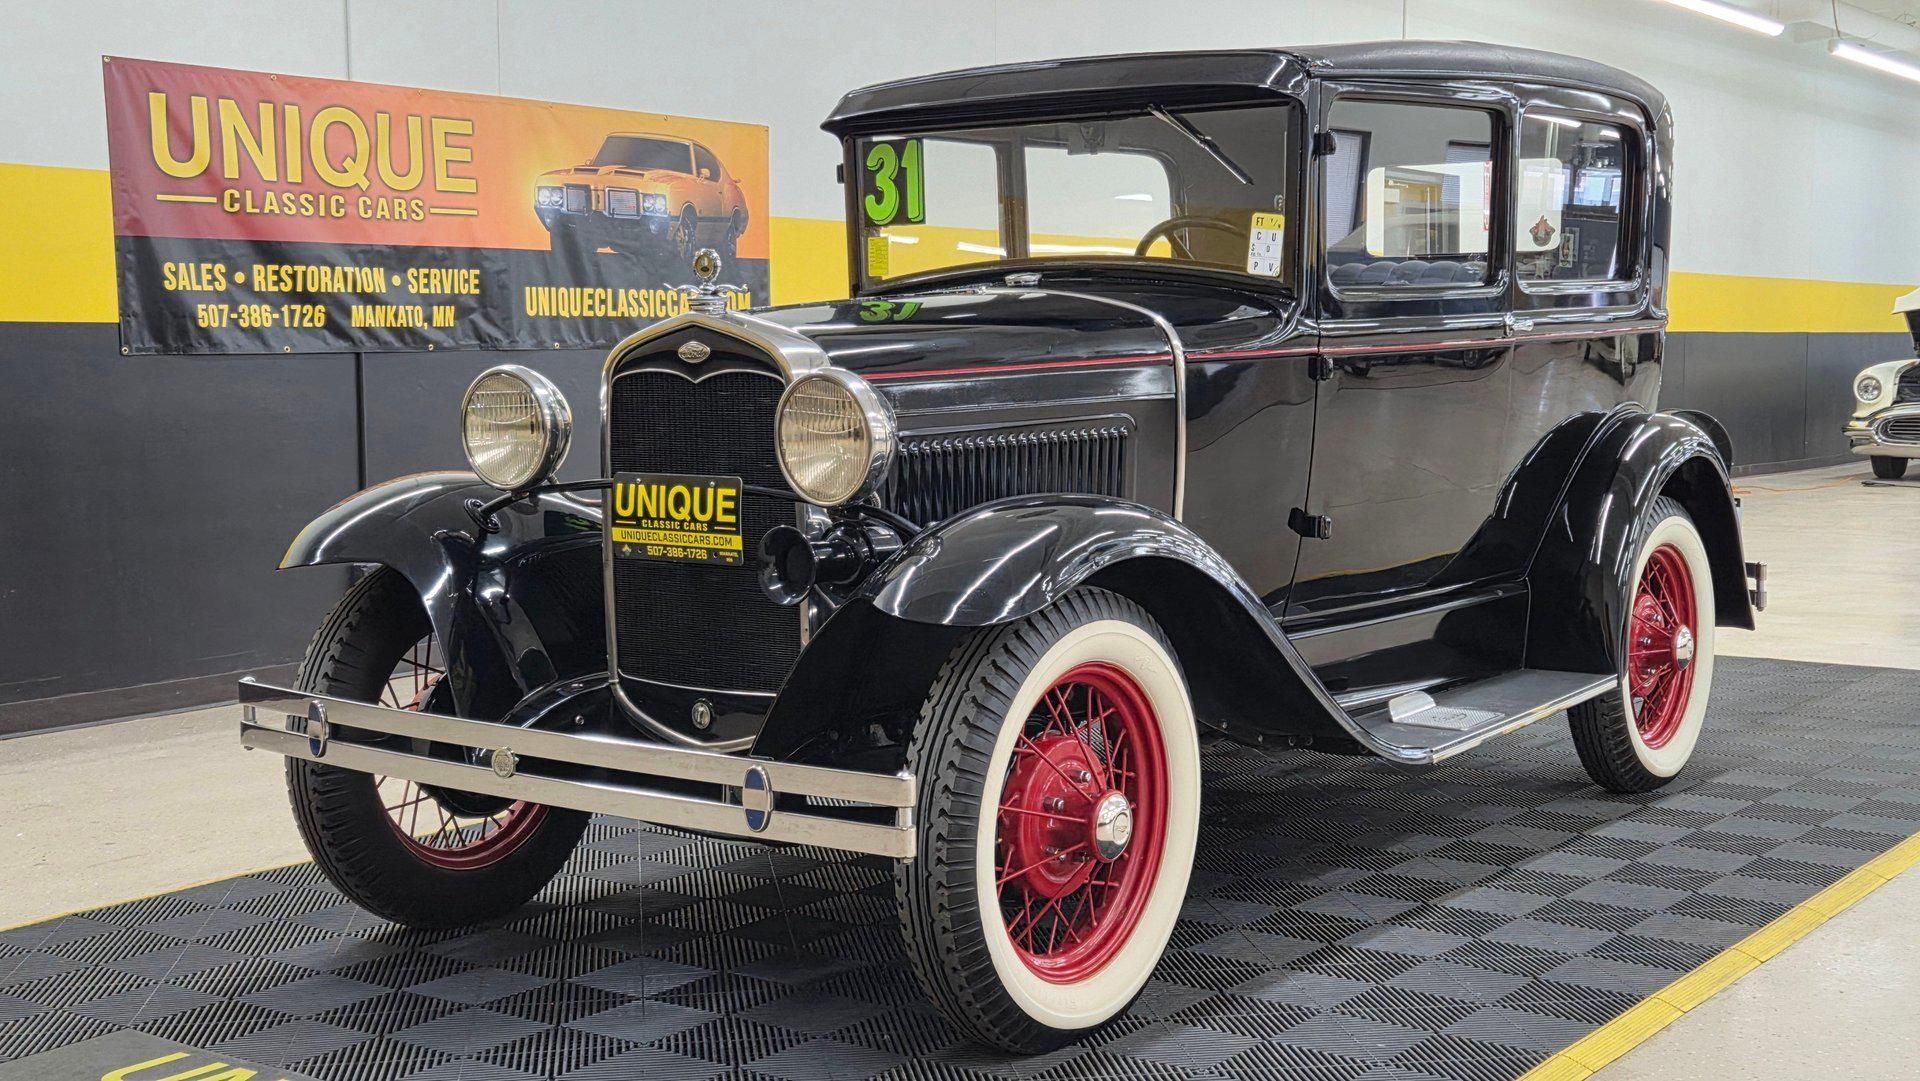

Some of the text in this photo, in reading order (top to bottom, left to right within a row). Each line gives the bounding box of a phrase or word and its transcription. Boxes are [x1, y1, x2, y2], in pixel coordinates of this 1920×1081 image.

[149, 92, 477, 192] UNIQUE
[865, 139, 924, 225] 31
[223, 189, 425, 221] CLASSIC CARS
[163, 262, 480, 295] SALES RESTORATION SERVICE
[197, 304, 455, 330] 507-386-1726 MANKATO, MN
[525, 286, 751, 317] UNIQUECLASSICCAOM
[615, 483, 737, 523] UNIQUE
[621, 531, 733, 547] UNIQUECLASSICCARS.COM
[642, 519, 708, 532] CLASSIC CARS
[647, 546, 708, 560] 507-386-1726
